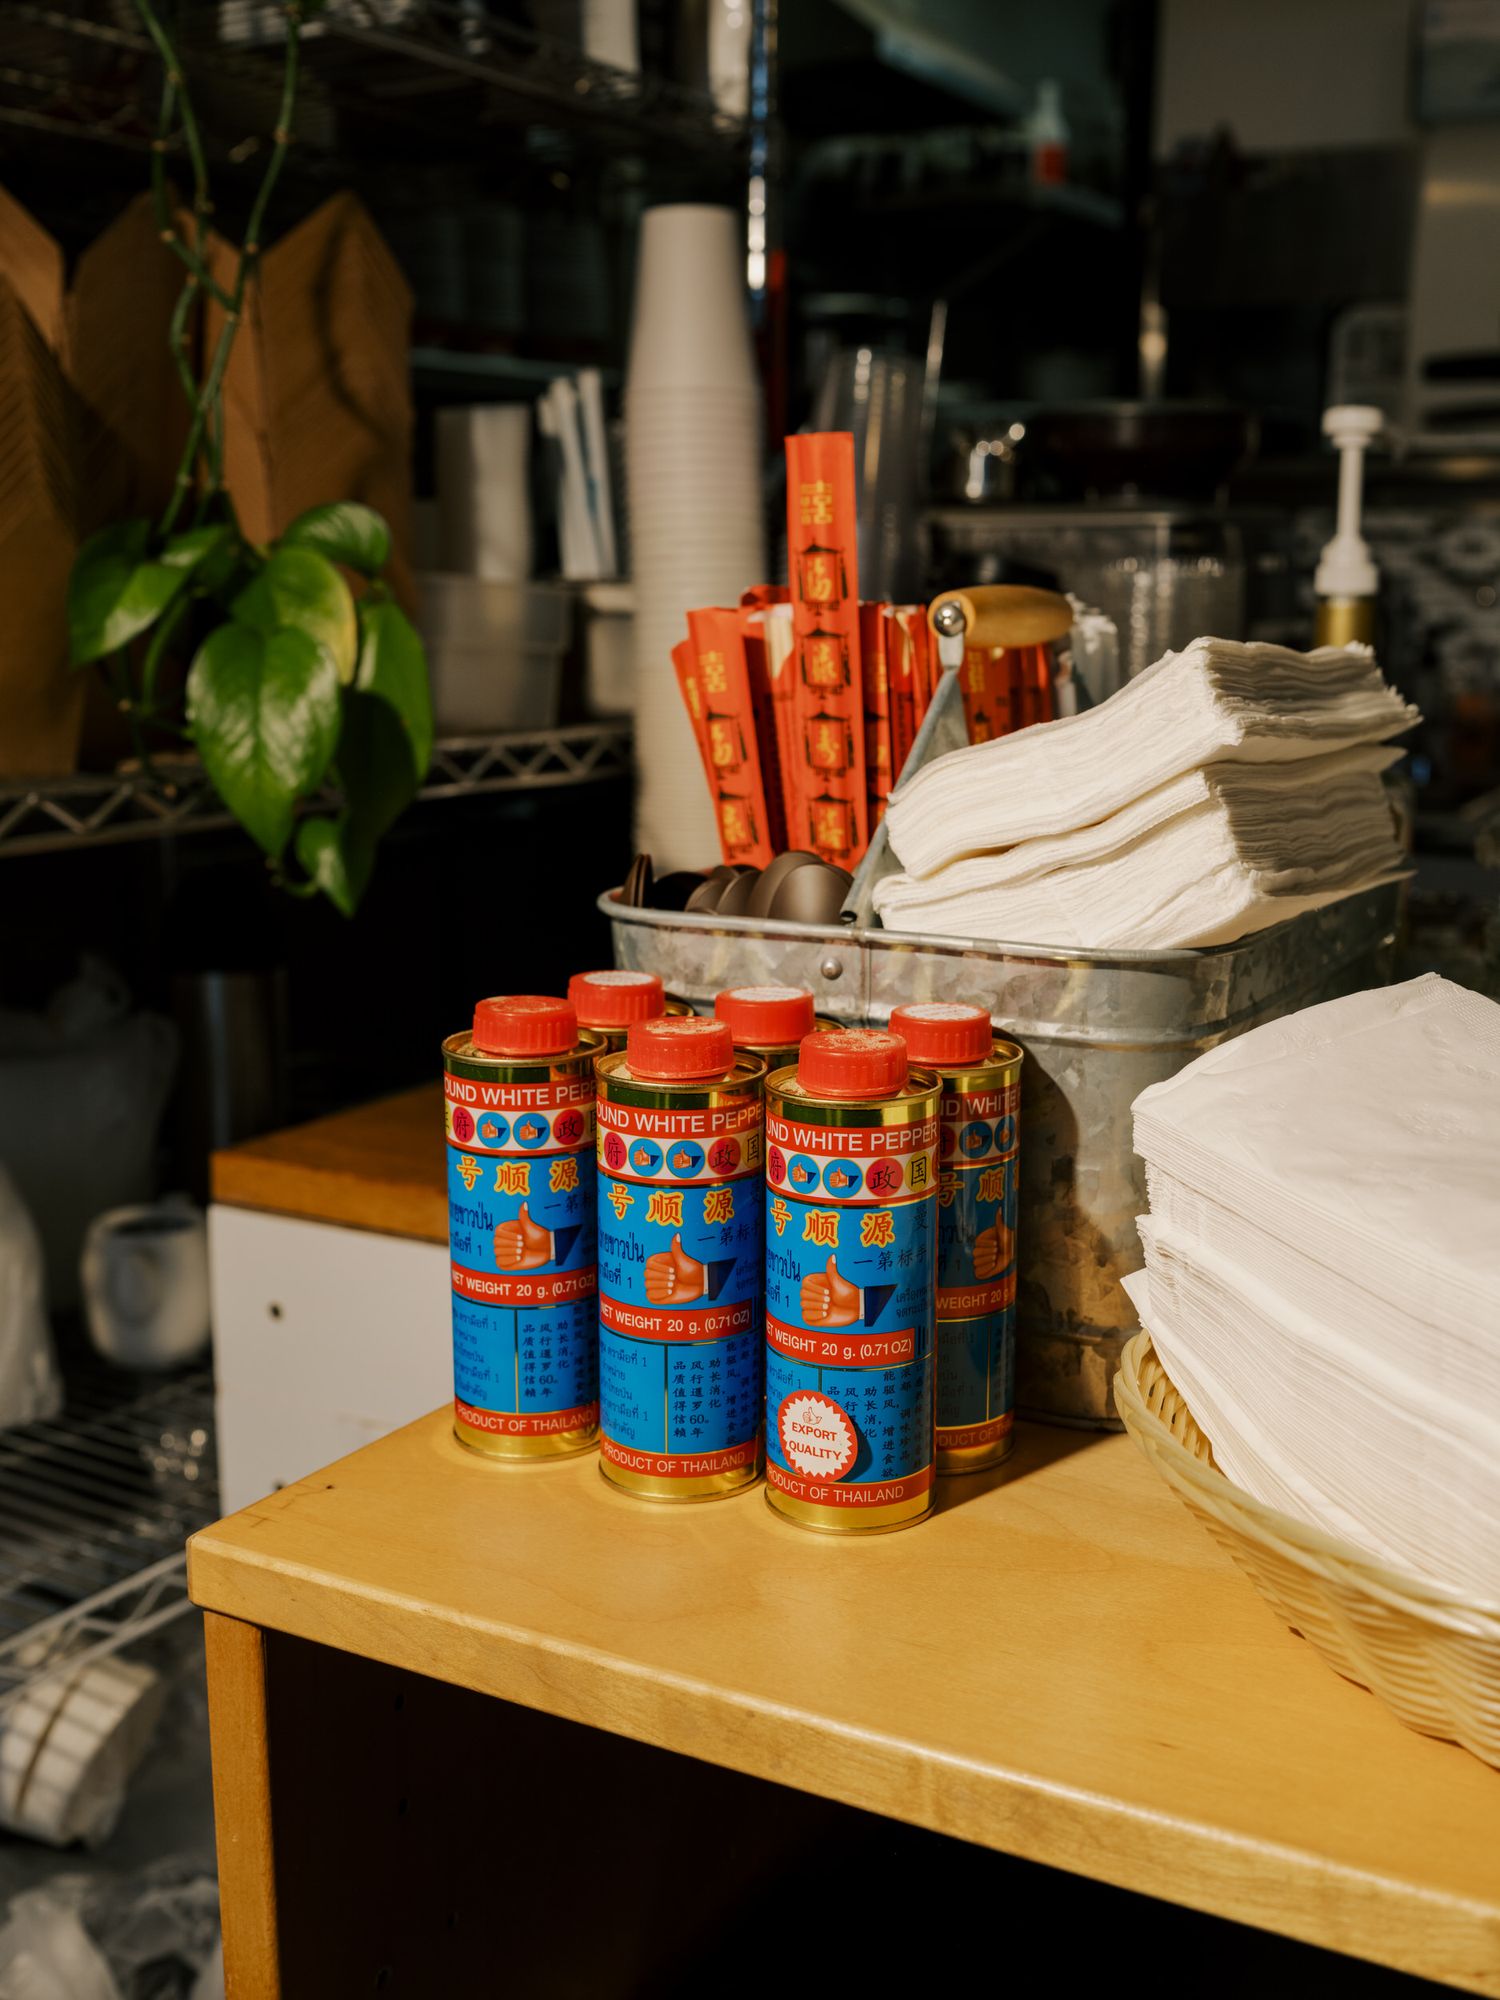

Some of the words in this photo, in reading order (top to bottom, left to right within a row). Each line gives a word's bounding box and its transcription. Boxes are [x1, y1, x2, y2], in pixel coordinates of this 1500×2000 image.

[481, 1086, 549, 1106] WHITE
[966, 1089, 1017, 1116] WHITE
[634, 1113, 705, 1133] WHITE
[793, 1127, 863, 1152] WHITE
[870, 1121, 938, 1151] PEPPER
[466, 1275, 512, 1297] WEIGHT
[516, 1284, 532, 1297] 20
[615, 1308, 662, 1331] WEIGHT
[667, 1319, 684, 1332] 20
[775, 1329, 817, 1353] WEIGHT
[821, 1341, 838, 1356] 20
[843, 1346, 856, 1360] g.
[458, 1404, 505, 1430] PRODUCT
[508, 1418, 527, 1432] OF
[531, 1411, 593, 1432] THAILAND
[792, 1421, 838, 1442] EXPORT
[604, 1441, 652, 1472] PRODUCT
[657, 1460, 676, 1473] OF
[681, 1451, 745, 1473] THAILAND
[789, 1441, 842, 1461] QUALITY
[809, 1486, 828, 1500] OF
[833, 1485, 904, 1503] THAILAND
